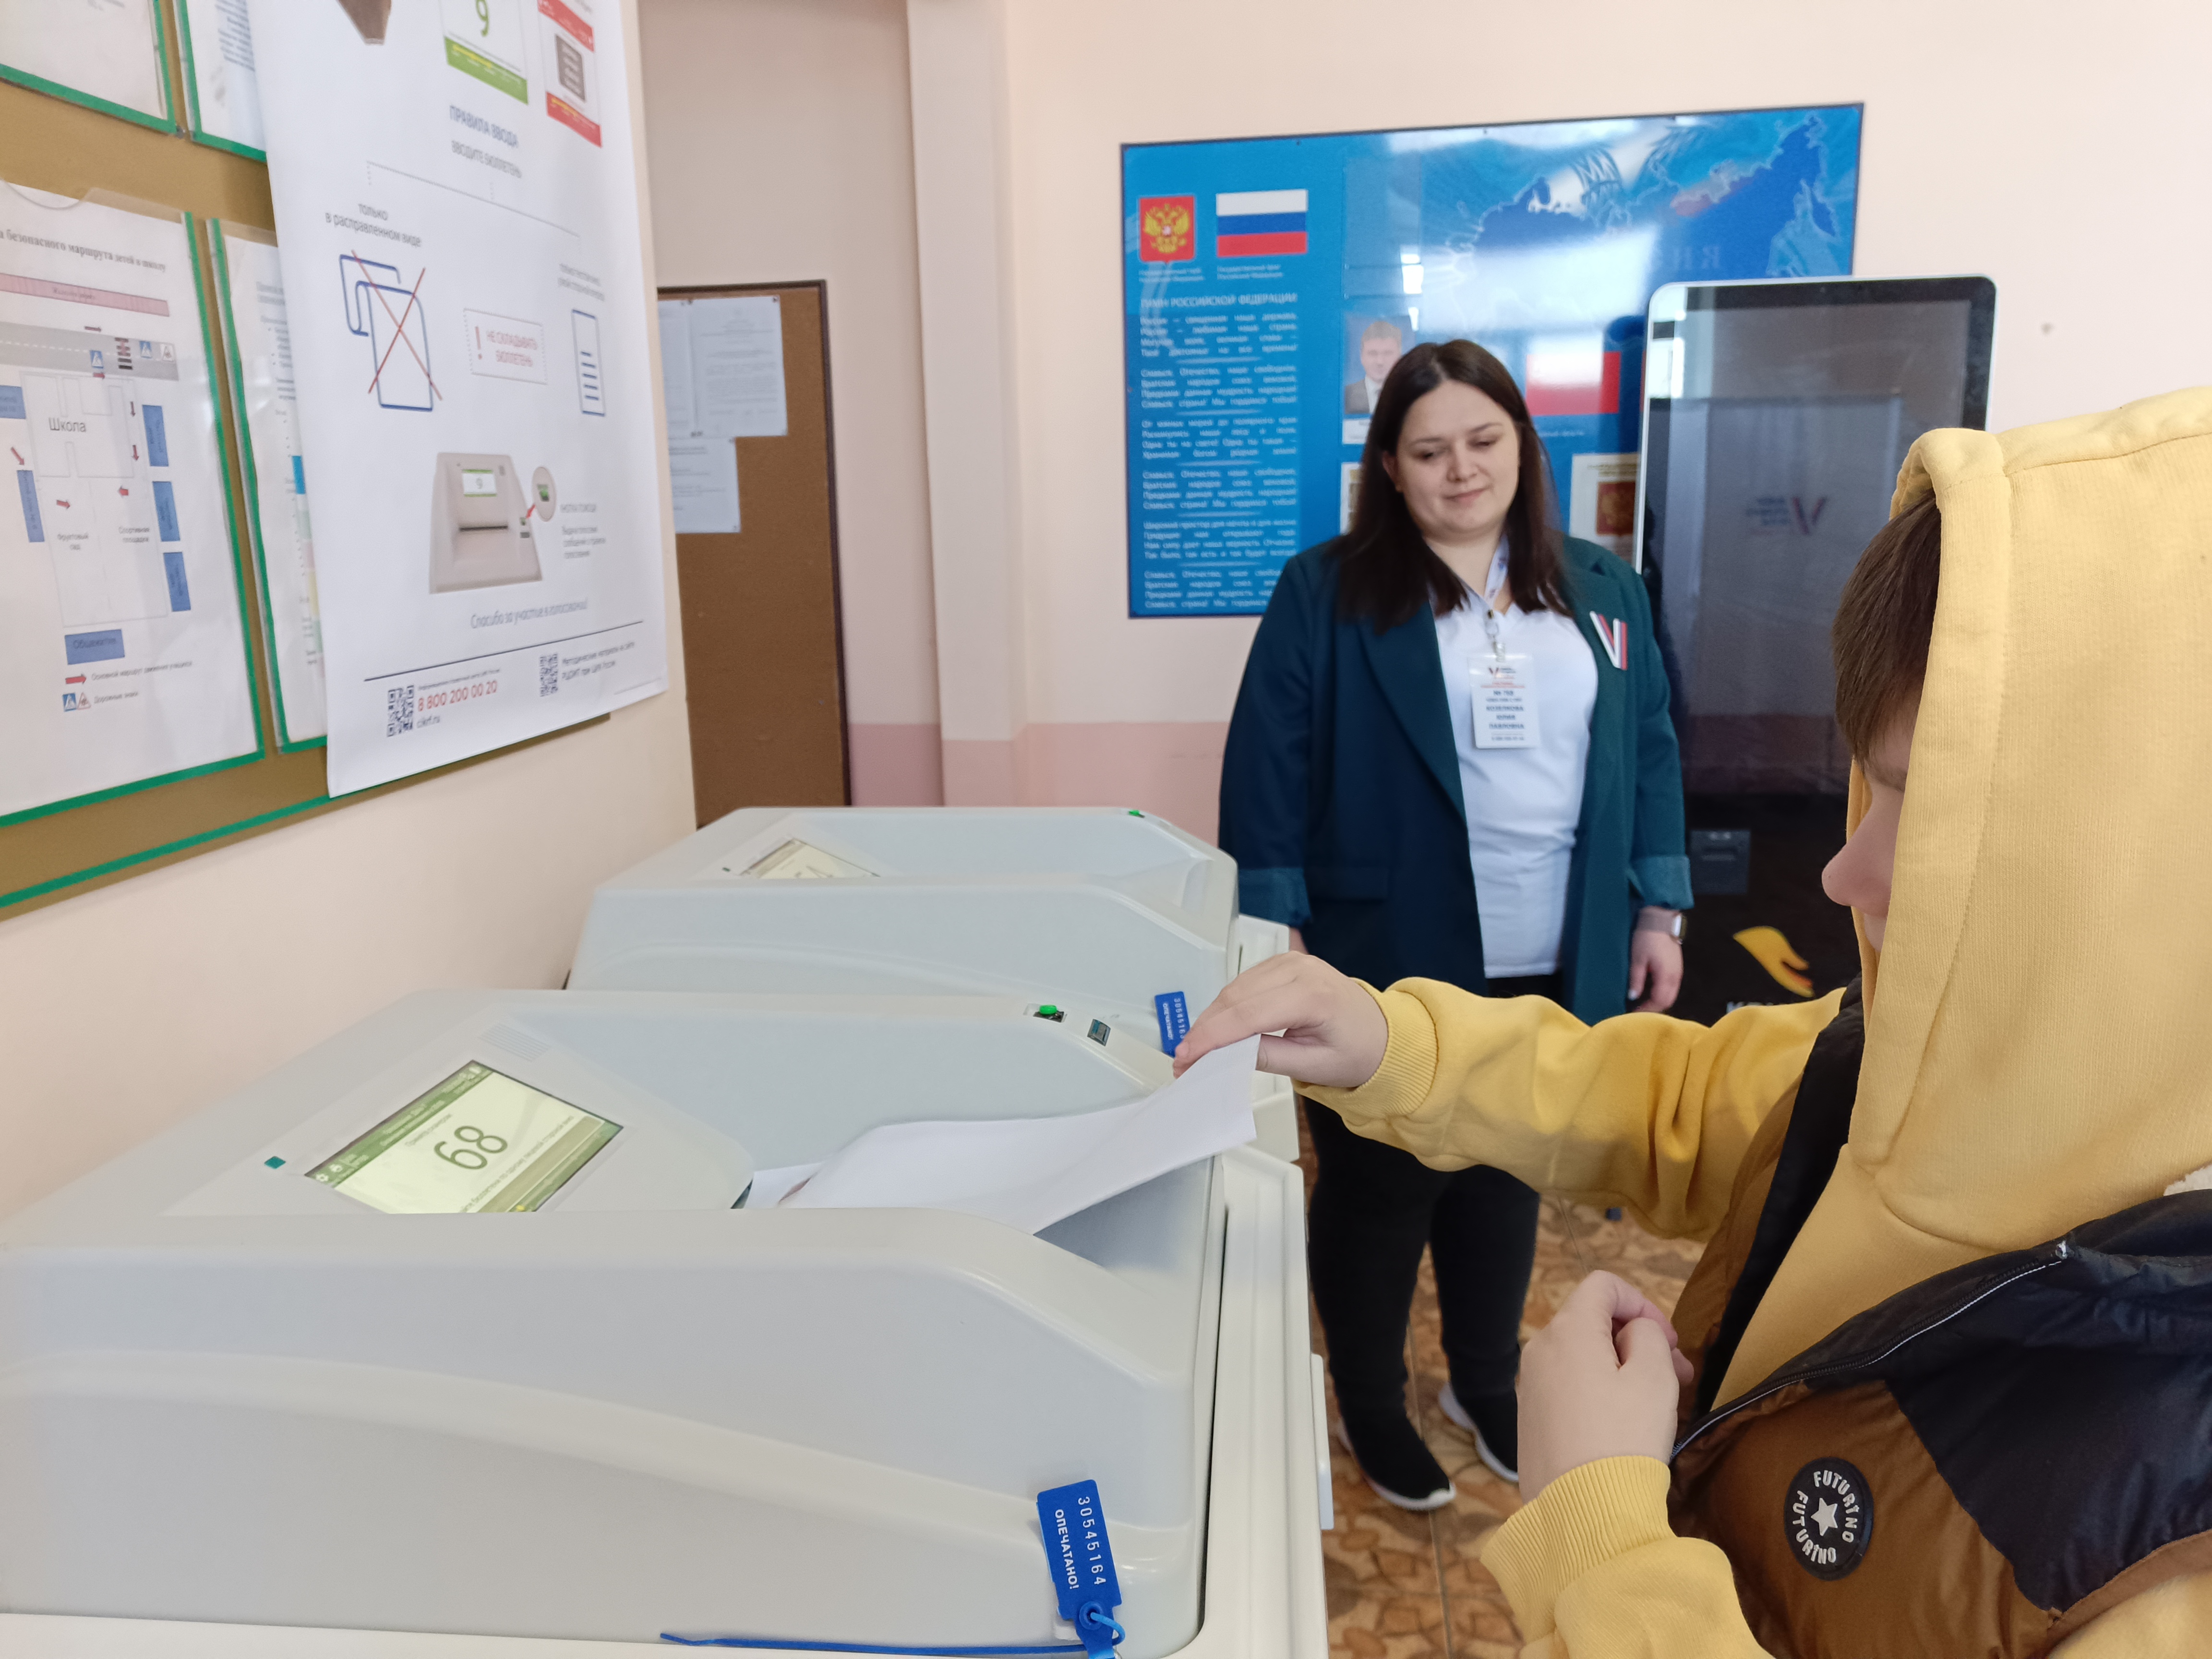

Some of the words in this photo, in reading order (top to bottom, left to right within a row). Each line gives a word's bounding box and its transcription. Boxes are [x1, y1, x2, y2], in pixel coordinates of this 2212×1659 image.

[333, 215, 401, 241] расправленном
[358, 204, 388, 221] только
[7, 229, 66, 251] безопасного
[68, 244, 113, 261] маршрута
[48, 417, 86, 433] Школа
[418, 697, 424, 711] 8
[427, 692, 447, 709] 800
[450, 687, 469, 704] 200
[471, 683, 483, 698] 00
[486, 680, 497, 695] 20
[1163, 1003, 1174, 1040] ОПЕЧАТАНО!
[433, 1124, 509, 1171] 68
[1813, 1470, 1859, 1543] FUTURINO
[1055, 1509, 1079, 1589] ОПЕЧАТАНО!
[1078, 1496, 1106, 1585] 30545164
